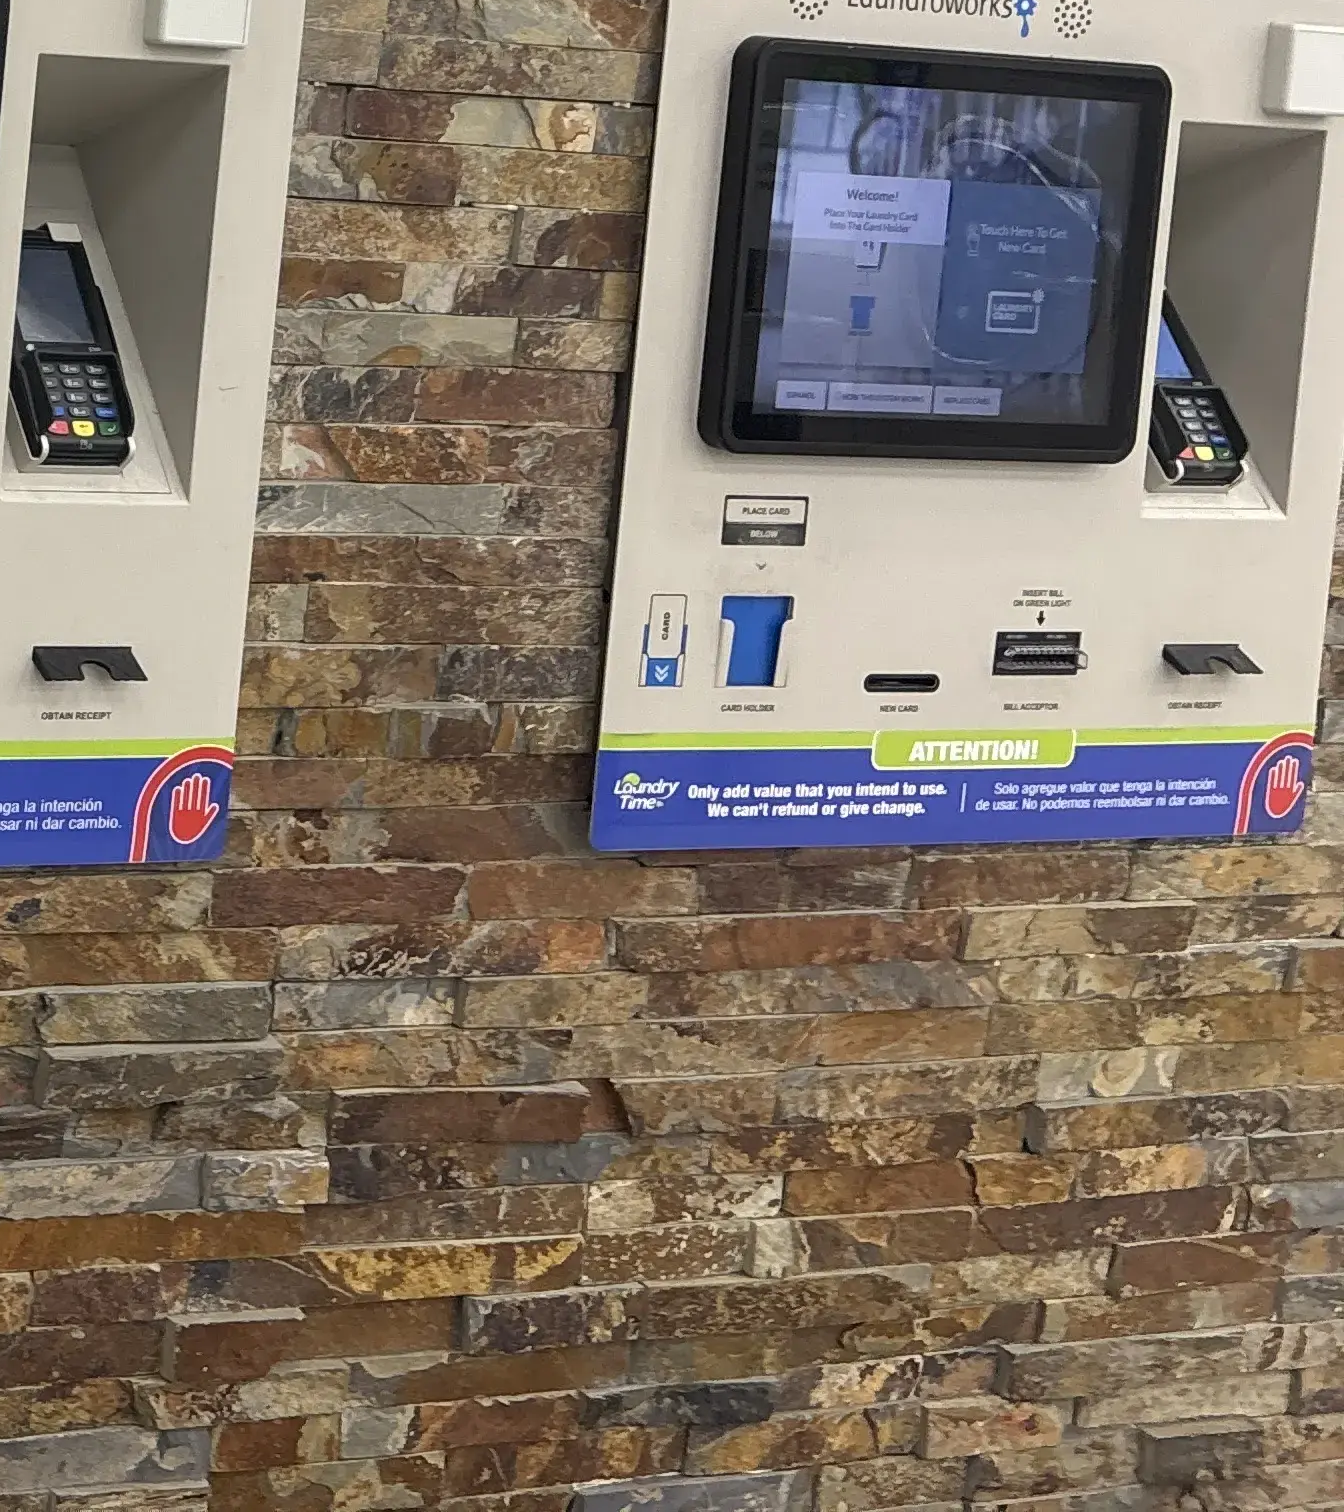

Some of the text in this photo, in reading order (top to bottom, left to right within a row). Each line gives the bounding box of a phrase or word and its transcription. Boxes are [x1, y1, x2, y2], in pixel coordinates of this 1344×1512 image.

[908, 739, 1039, 762] ATTENTION!
[688, 783, 947, 801] Only add value that you intend to use.
[23, 799, 37, 812] la
[41, 798, 103, 813] intención
